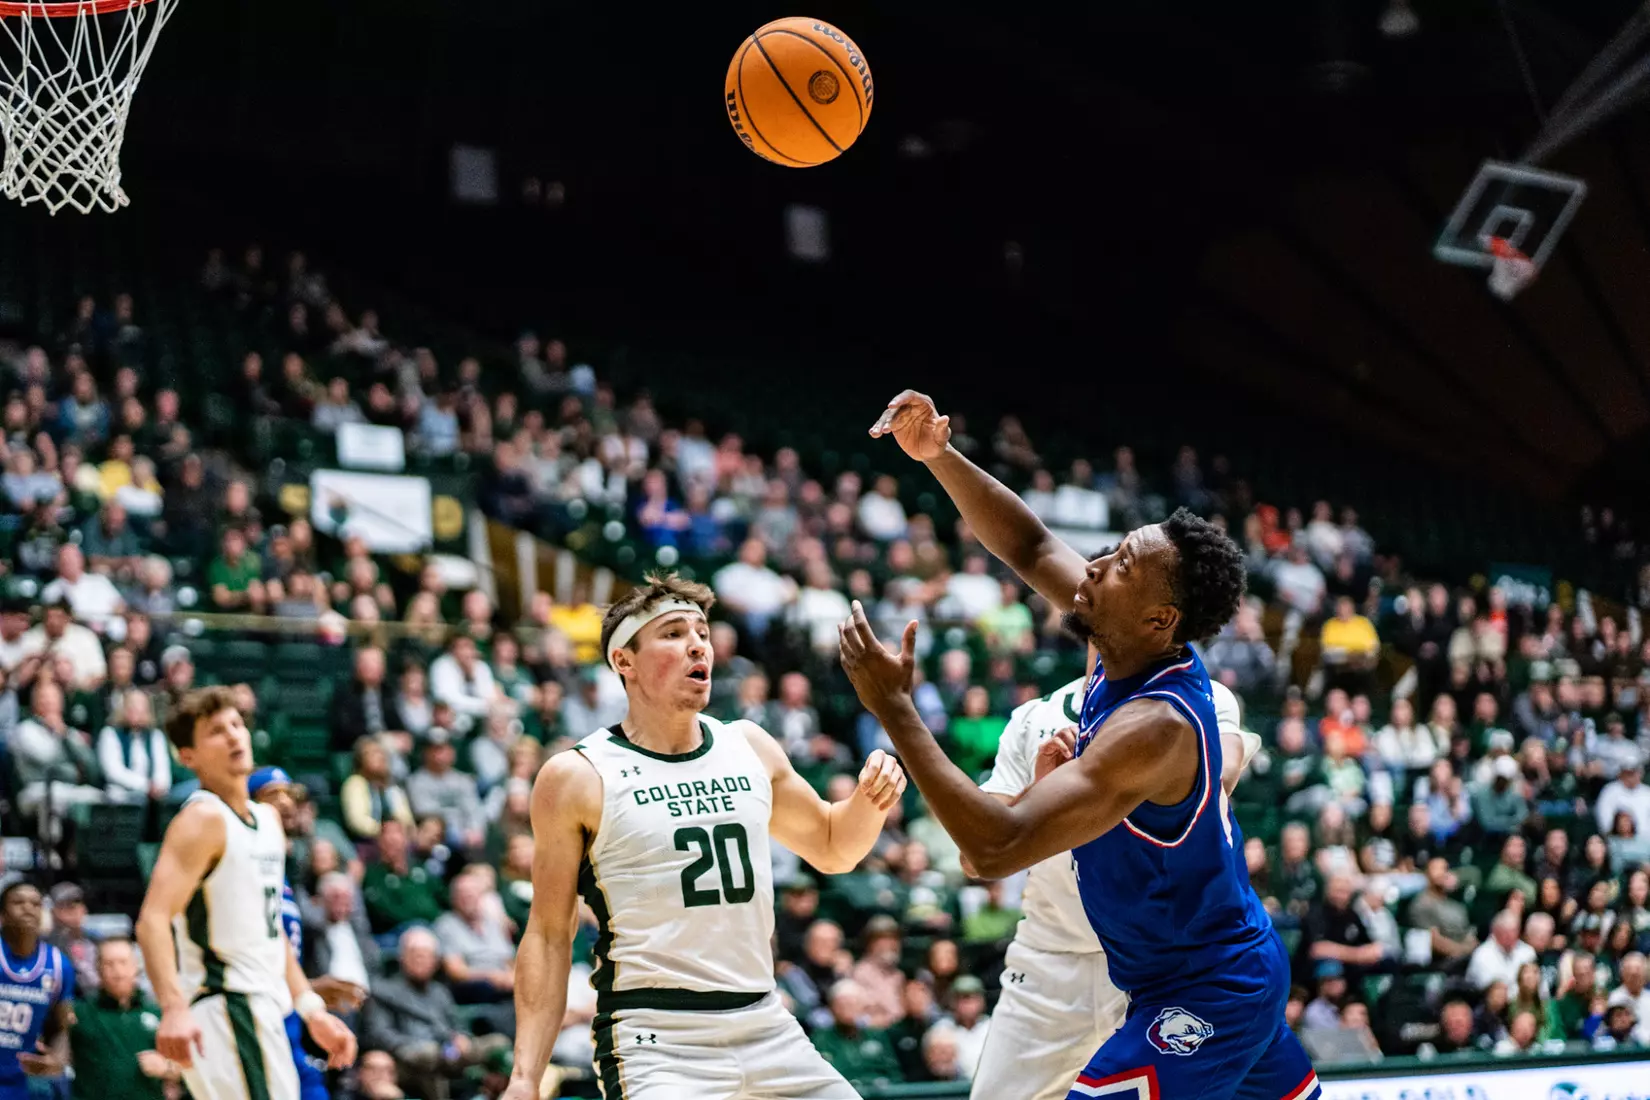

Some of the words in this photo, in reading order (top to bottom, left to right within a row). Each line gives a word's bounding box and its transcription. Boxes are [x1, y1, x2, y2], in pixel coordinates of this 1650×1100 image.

[633, 776, 752, 806] COLORADO
[667, 795, 736, 817] STATE
[674, 822, 755, 908] 20
